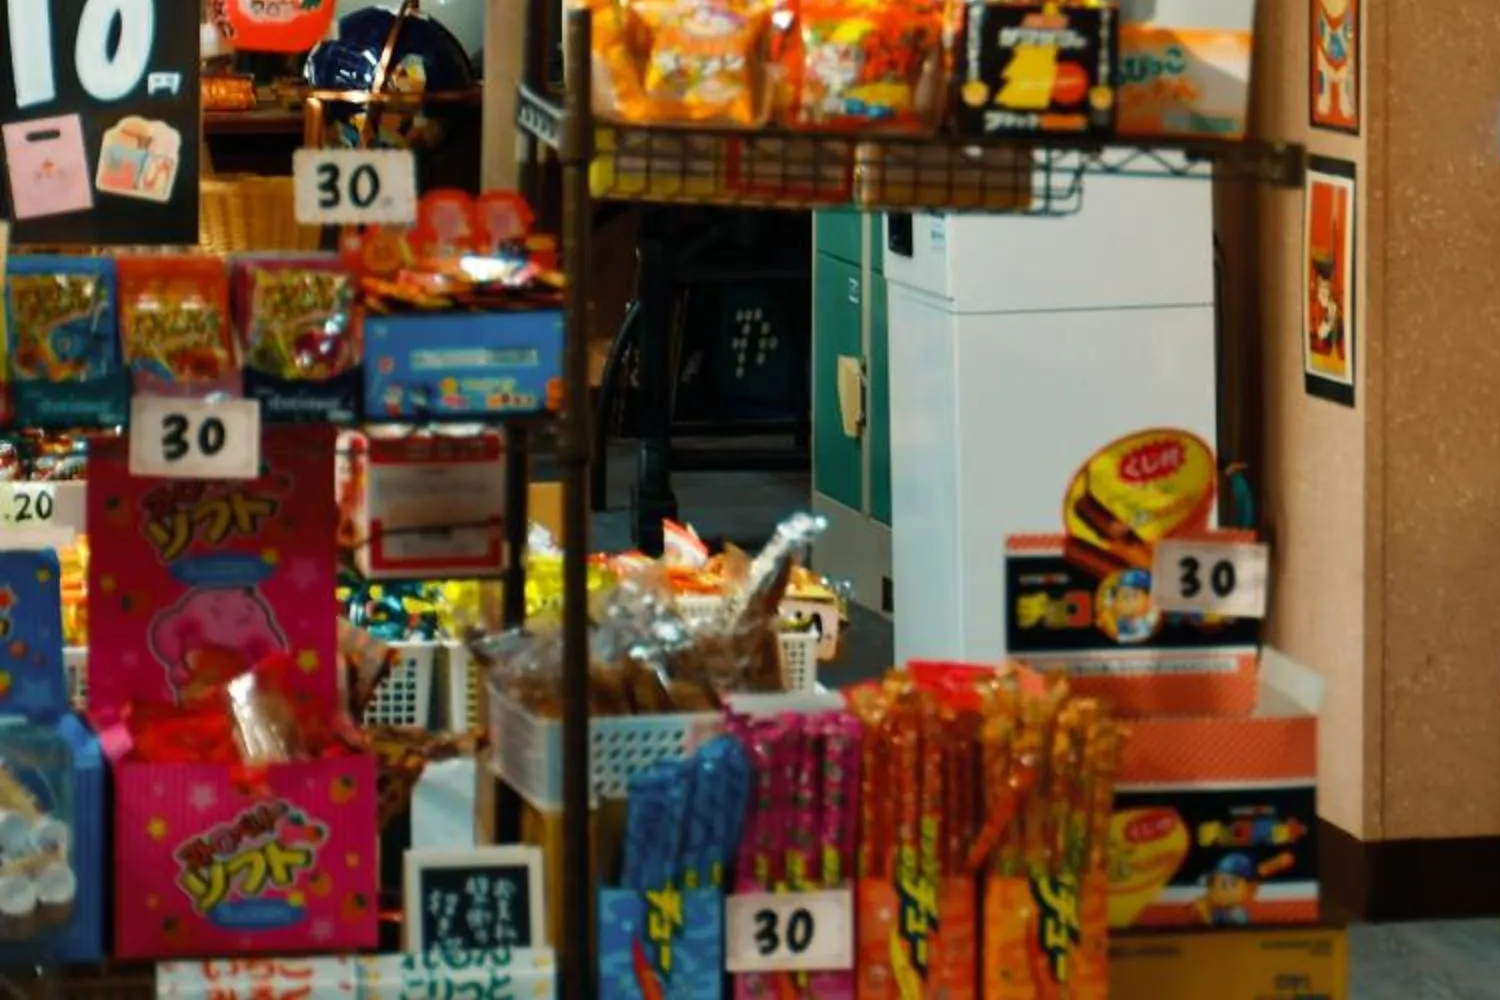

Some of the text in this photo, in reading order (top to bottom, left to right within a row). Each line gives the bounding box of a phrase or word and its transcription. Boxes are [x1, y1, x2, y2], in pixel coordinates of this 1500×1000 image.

[161, 412, 227, 462] 30
[147, 493, 276, 562] ソフト
[1179, 555, 1237, 599] 30
[182, 840, 312, 914] ソフト
[754, 907, 816, 957] 30
